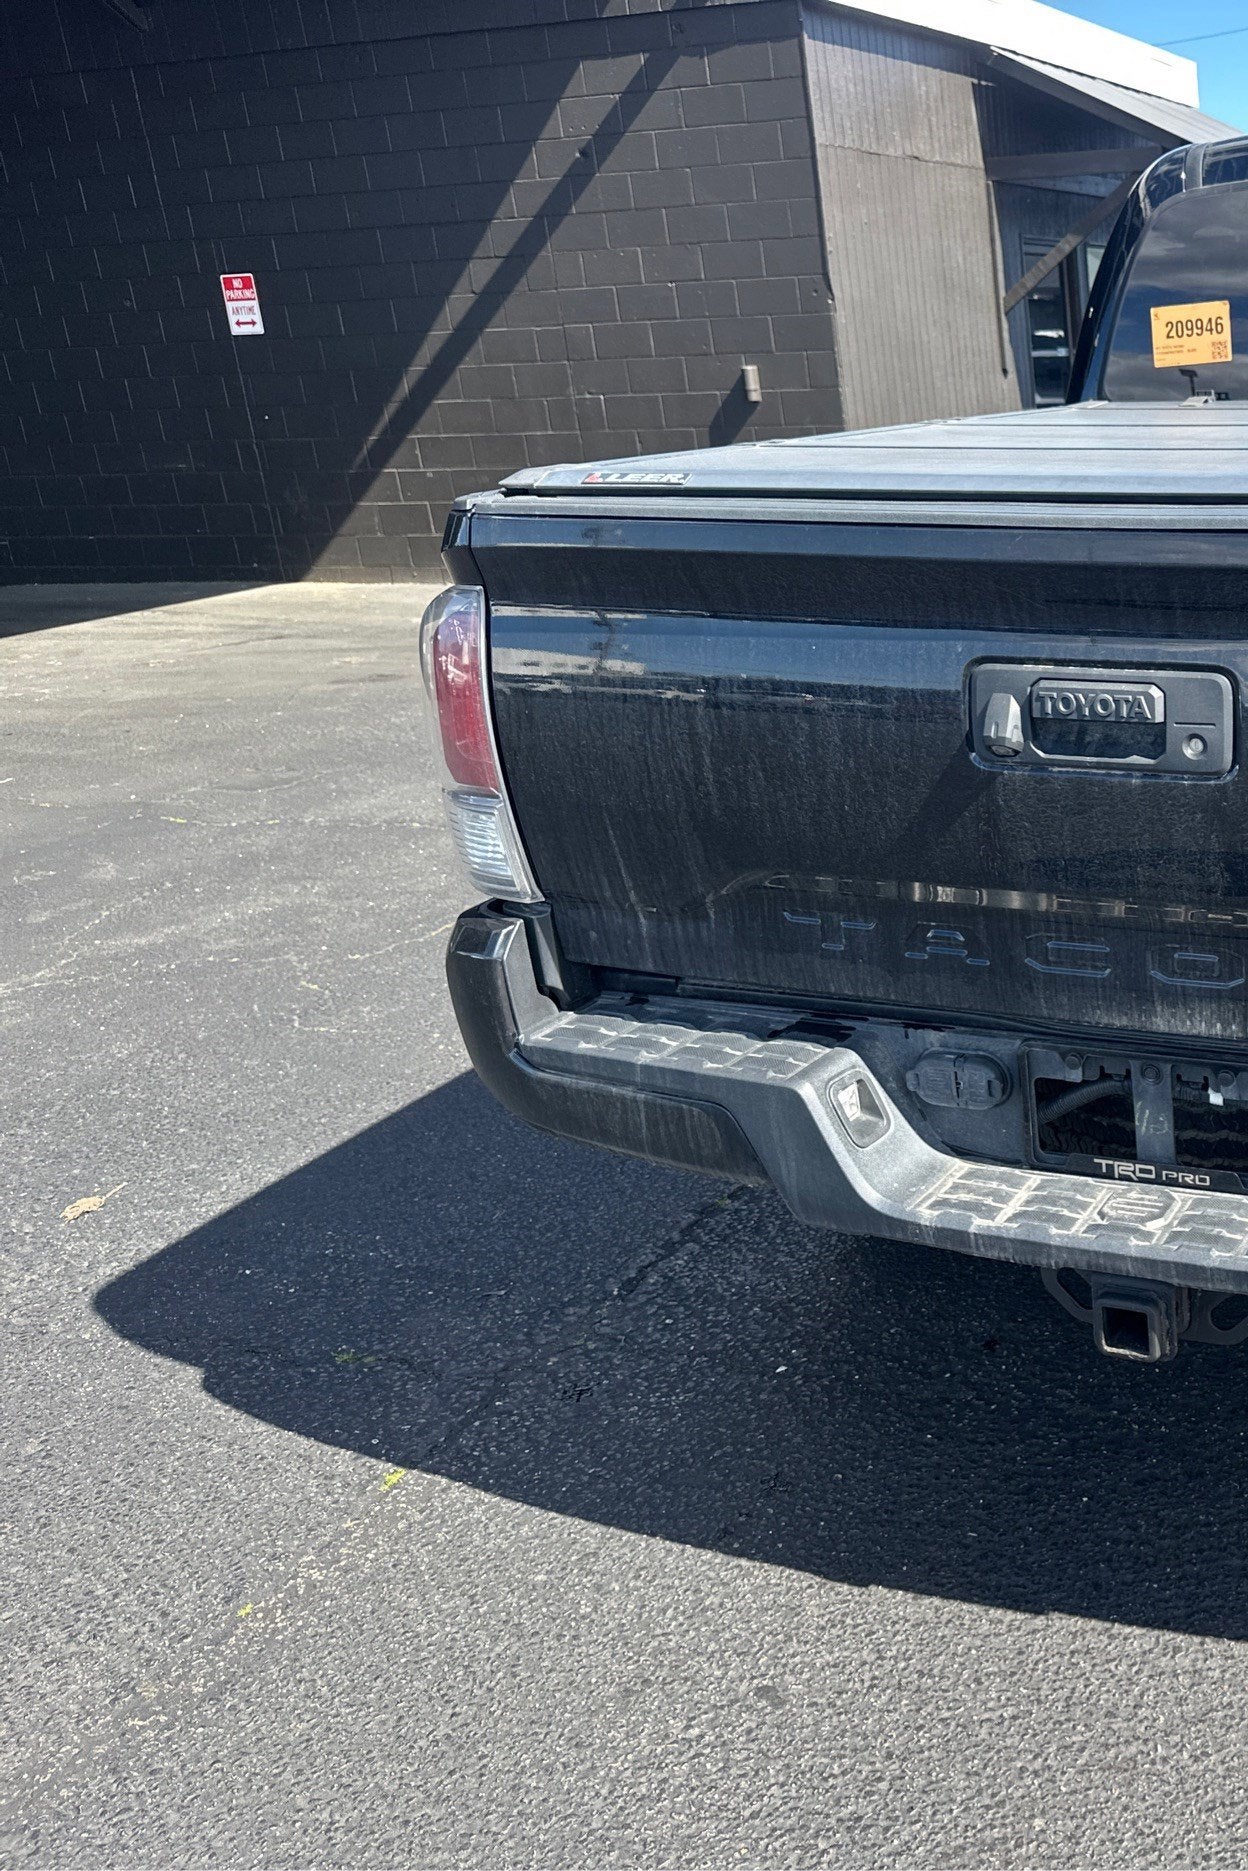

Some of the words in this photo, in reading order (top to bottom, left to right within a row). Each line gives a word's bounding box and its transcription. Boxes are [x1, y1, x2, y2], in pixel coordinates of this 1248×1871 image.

[232, 278, 243, 289] NO
[225, 289, 256, 300] PARKING
[231, 306, 256, 315] ANYTIME
[1165, 316, 1224, 340] 209946
[604, 472, 685, 484] LEER
[1038, 691, 1152, 720] TOYOTA
[1093, 1158, 1156, 1181] TRD
[1162, 1170, 1211, 1186] PRO
